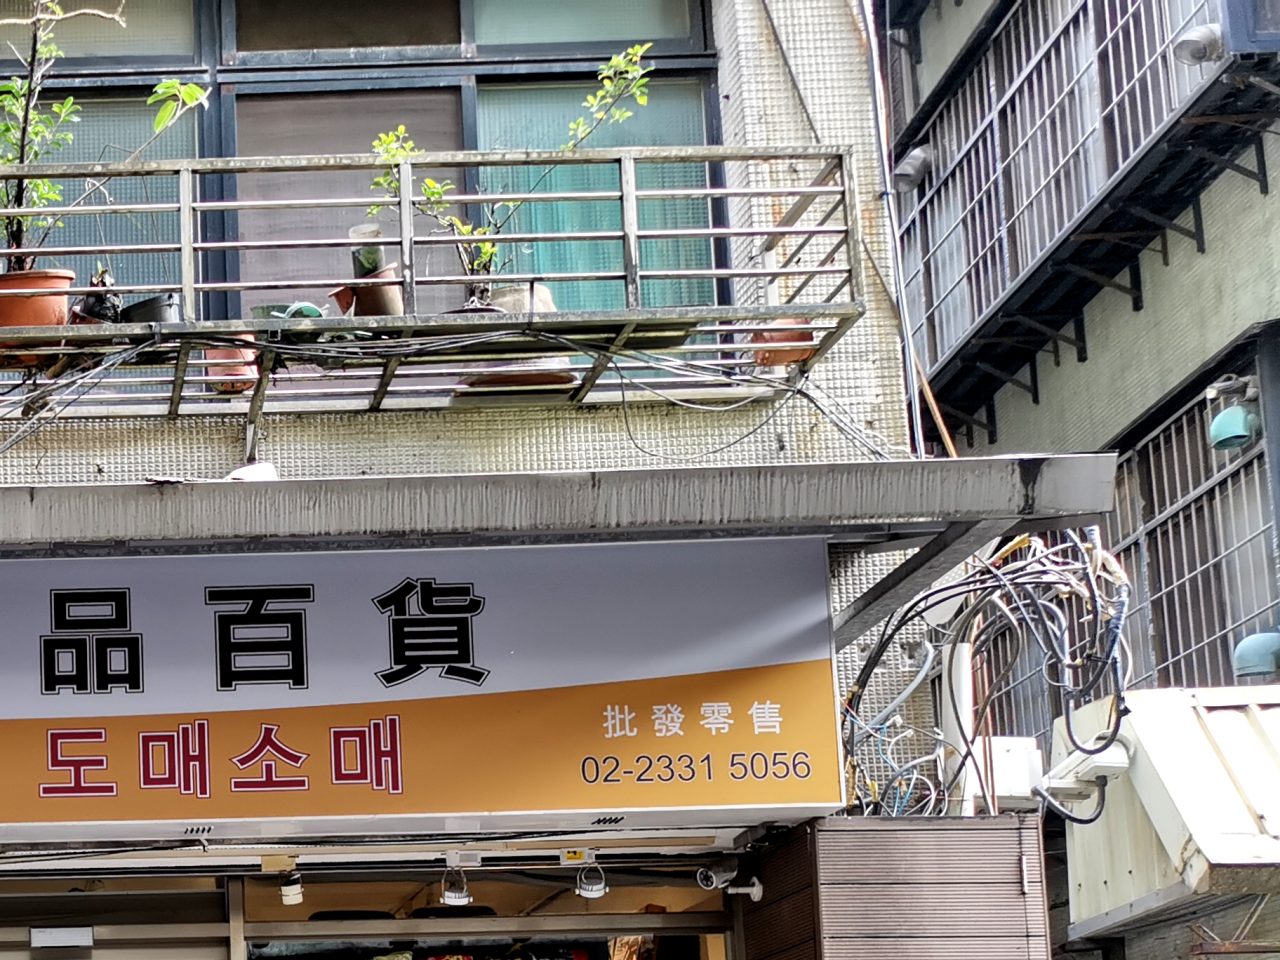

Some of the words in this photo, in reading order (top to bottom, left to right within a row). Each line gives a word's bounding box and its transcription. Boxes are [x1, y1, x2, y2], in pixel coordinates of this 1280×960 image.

[602, 701, 784, 739] 批發零售
[39, 714, 404, 798] 도매소매
[580, 754, 713, 784] 02-2331
[728, 751, 812, 781] 5056
